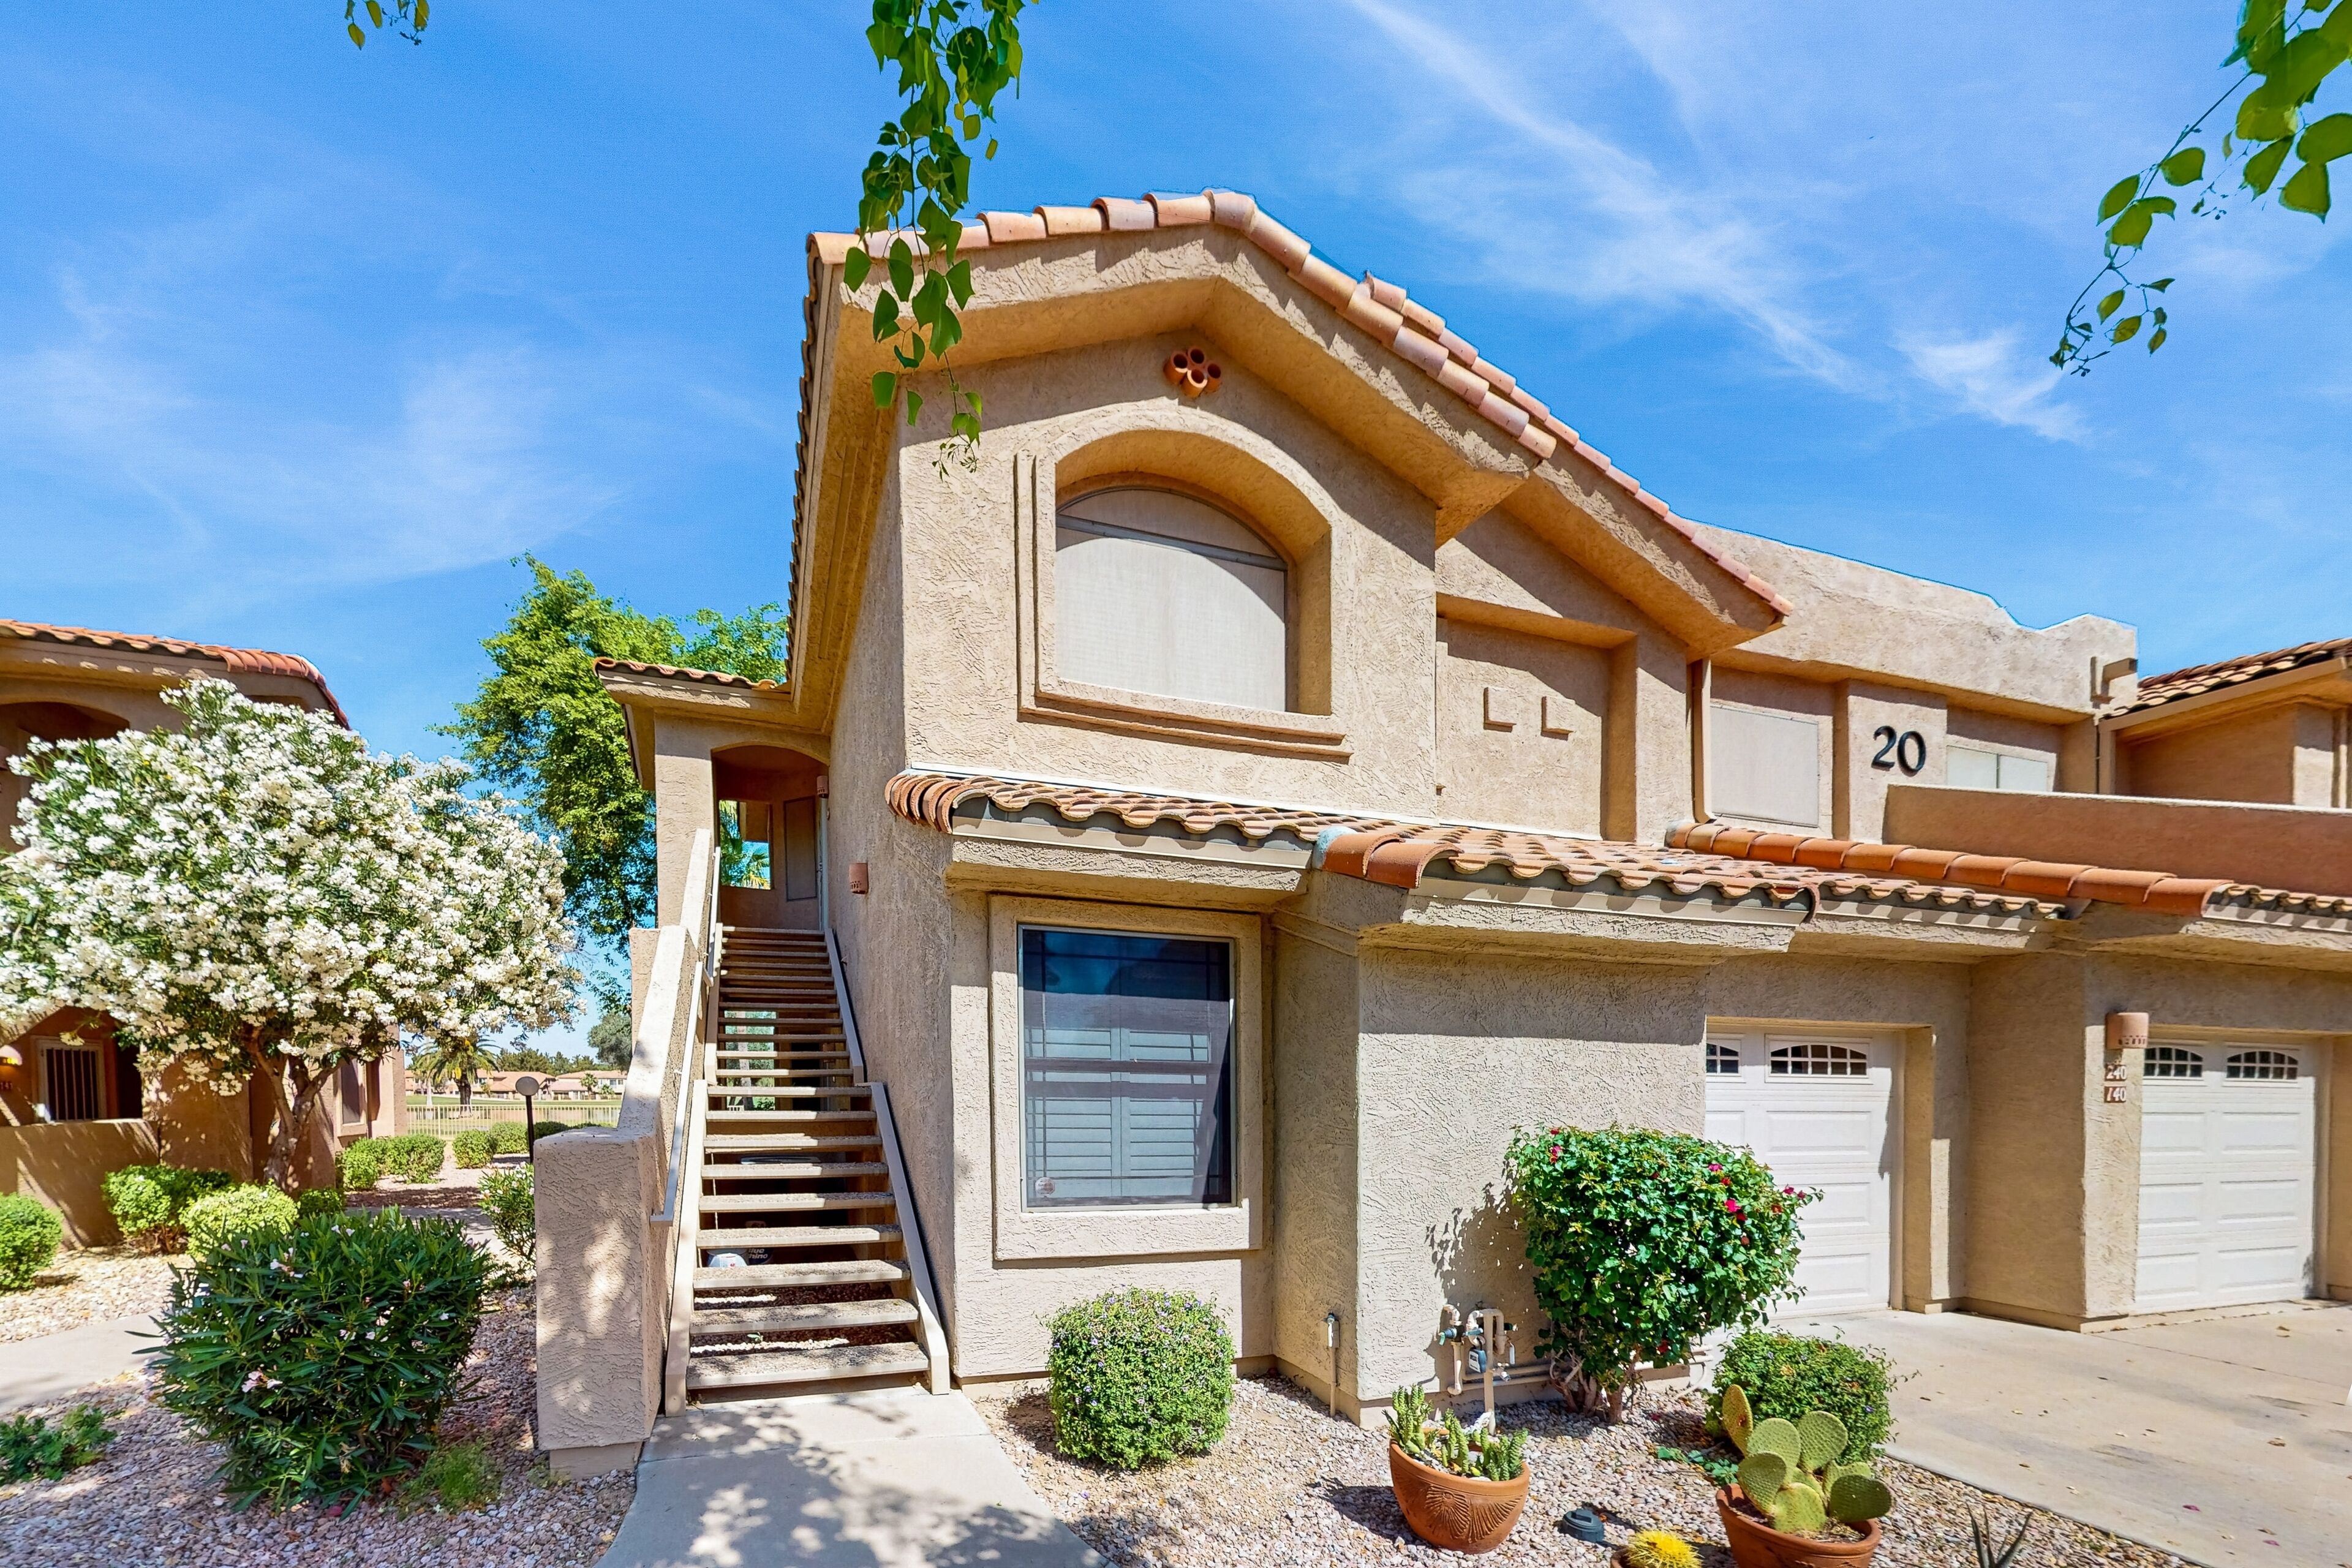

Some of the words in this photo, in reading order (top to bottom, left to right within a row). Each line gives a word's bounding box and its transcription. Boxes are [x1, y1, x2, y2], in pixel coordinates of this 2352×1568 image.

[1871, 725, 1926, 772] 20
[2106, 1065, 2127, 1080] 240
[2106, 1087, 2127, 1101] 140
